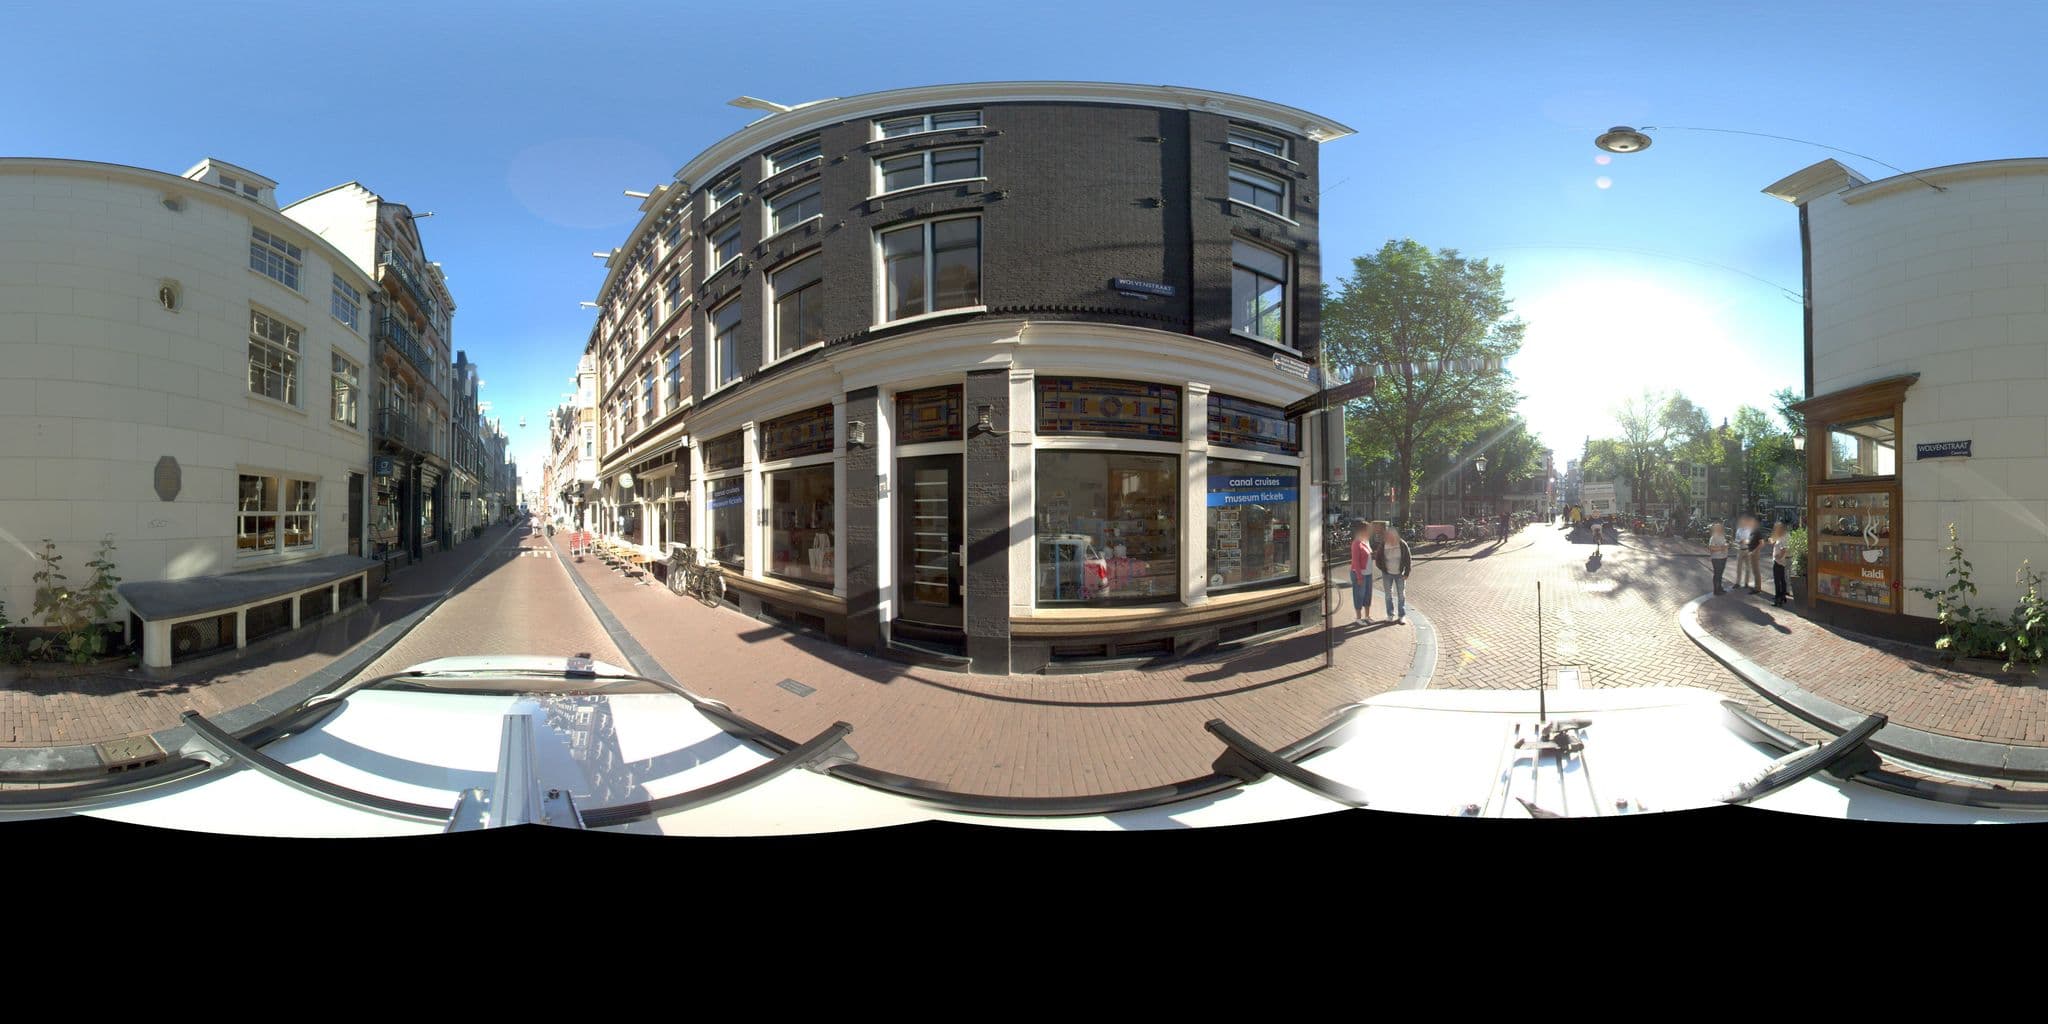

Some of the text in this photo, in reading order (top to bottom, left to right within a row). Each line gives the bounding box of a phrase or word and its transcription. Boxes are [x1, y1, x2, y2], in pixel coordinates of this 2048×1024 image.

[1120, 279, 1172, 291] WOLVENSTRAAT
[1919, 442, 1968, 451] WOLVENSTRAAT
[1229, 477, 1280, 487] canal cruises
[1224, 492, 1284, 503] museum tickets
[1861, 567, 1884, 579] kaldi
